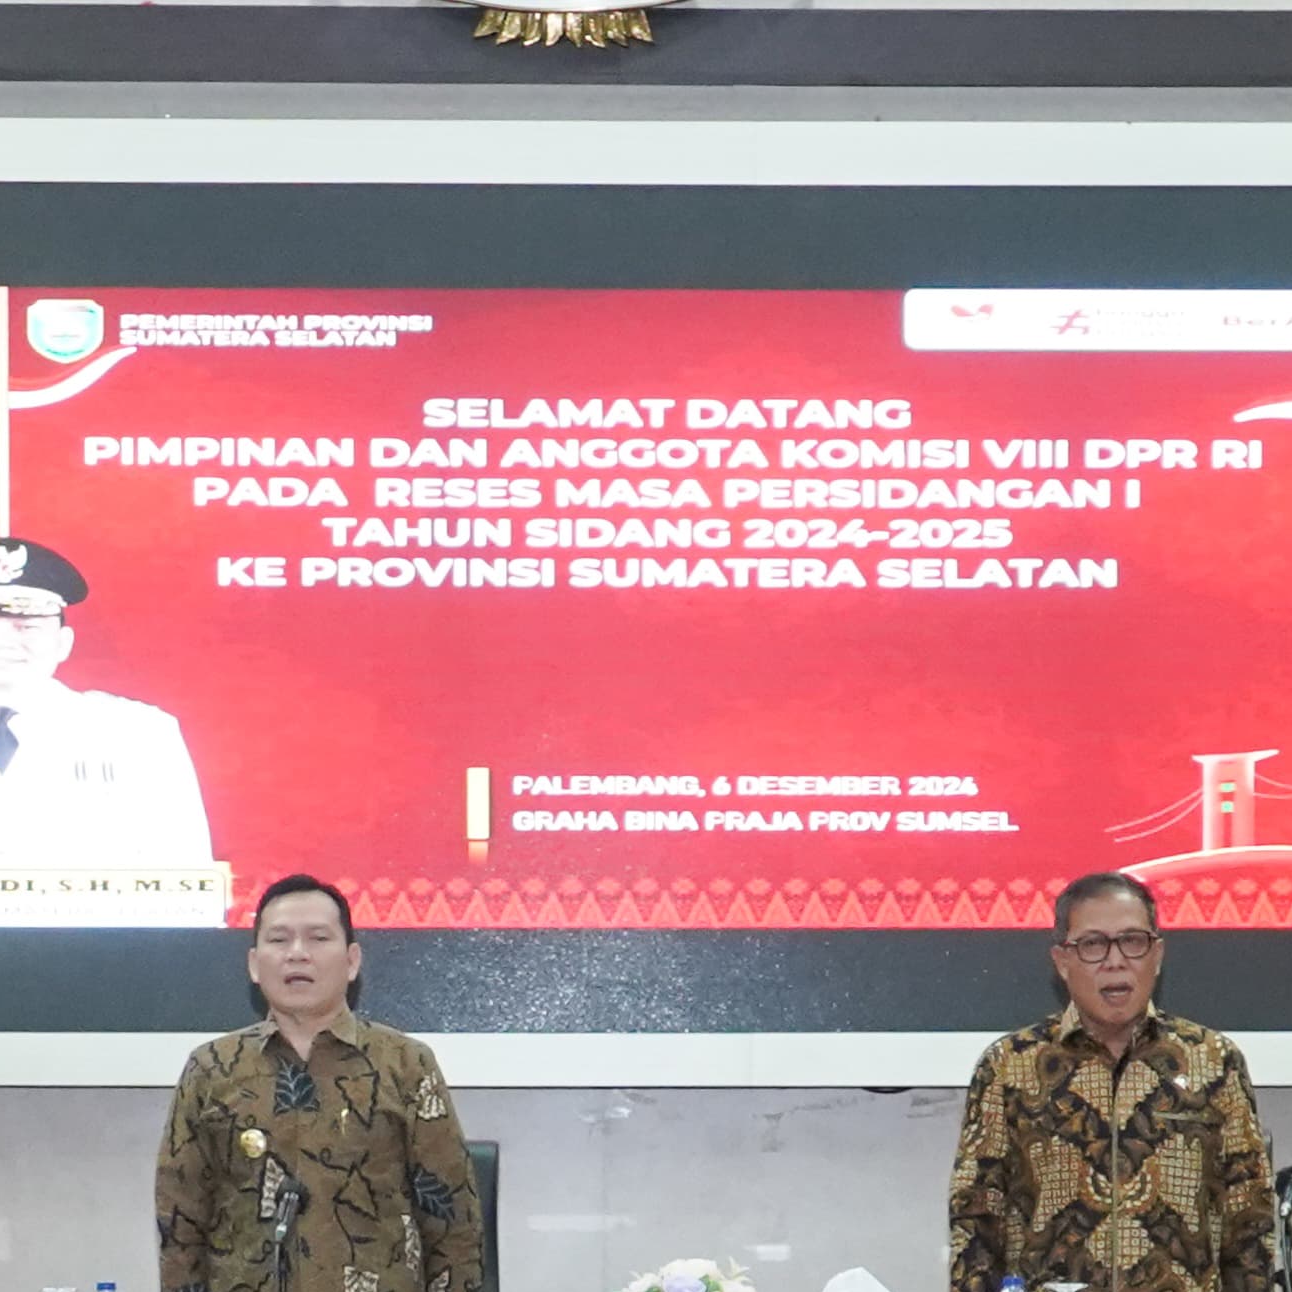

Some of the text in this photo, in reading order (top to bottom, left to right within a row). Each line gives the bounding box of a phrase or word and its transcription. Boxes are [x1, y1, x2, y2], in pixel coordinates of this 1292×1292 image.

[119, 313, 433, 332] PEMERINTAH PROVINSI
[119, 330, 397, 347] SUMATERA SELATAN
[422, 397, 912, 430] SELAMAT DATANG
[83, 436, 1263, 470] PIMPINAN DAN ANGGOTA KOMISI VIII DPR RI
[192, 476, 1141, 510] PADA RESES MASA PERSIDANGAN I
[320, 516, 1014, 549] TAHUN SIDANG 2024-2025
[216, 556, 1118, 589] KE PROVINSI SUMATERA SELATAN
[511, 775, 979, 798] PALEMBANG, 6 DESEMBER 2024
[511, 810, 1020, 833] GRAHA BINA PRAJA PROV SUMSEL
